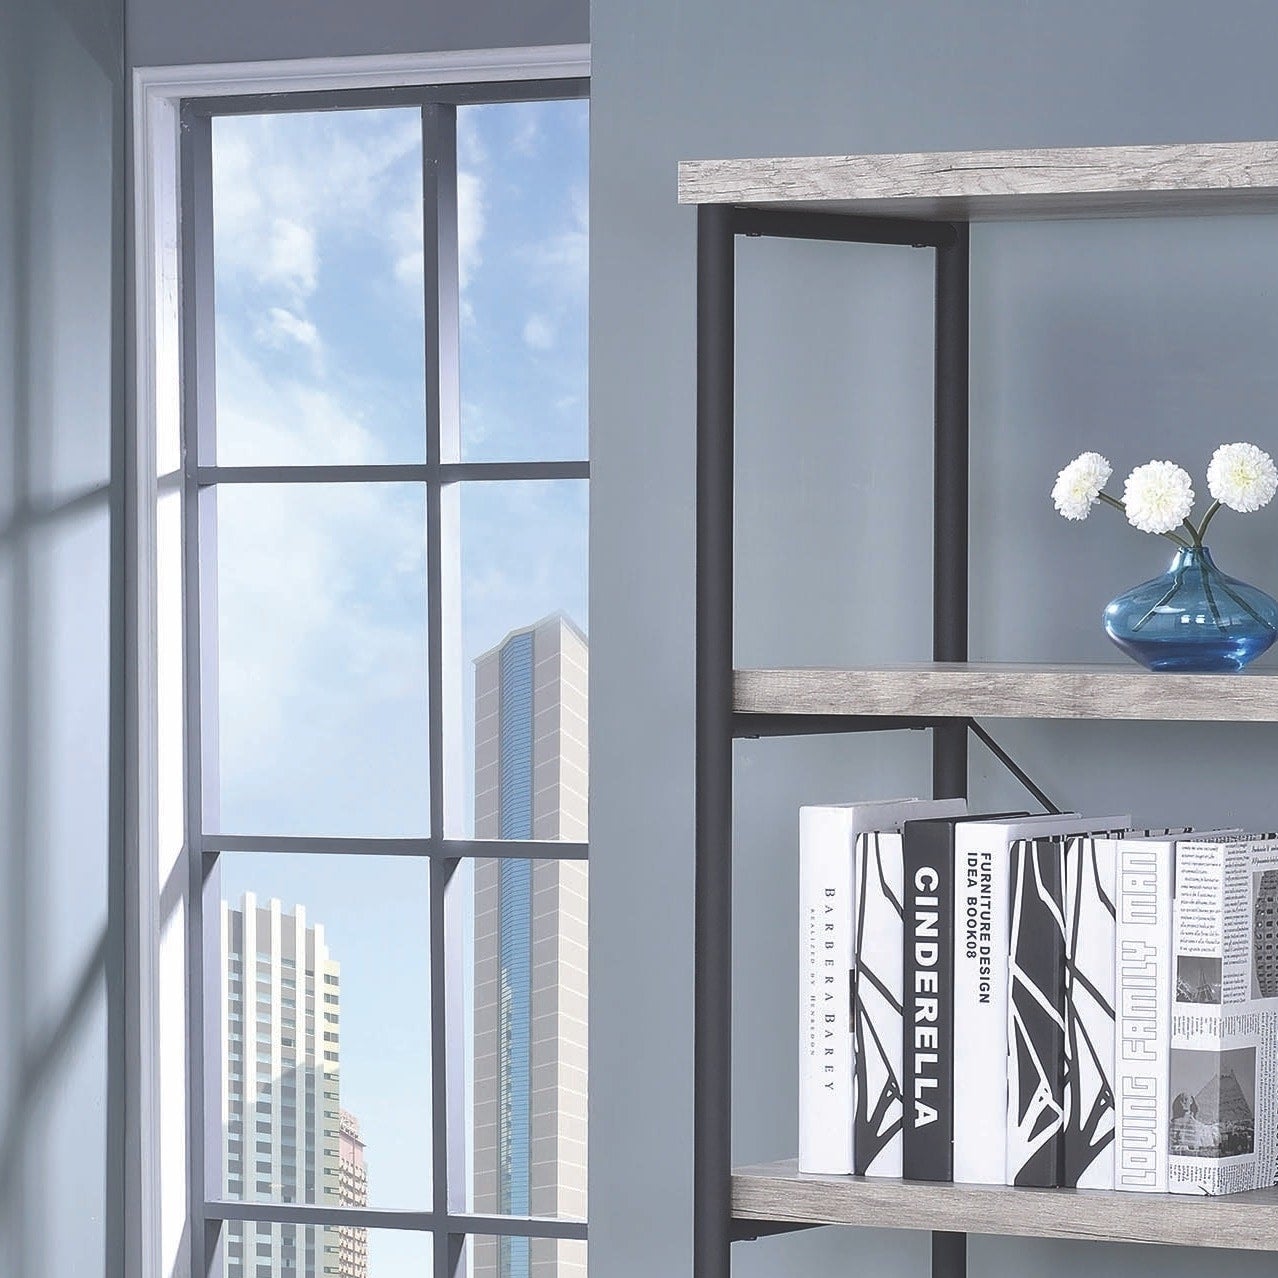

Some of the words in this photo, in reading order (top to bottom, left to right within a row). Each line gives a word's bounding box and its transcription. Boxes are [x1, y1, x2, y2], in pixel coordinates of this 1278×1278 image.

[967, 852, 977, 888] IDEA
[980, 852, 991, 942] FURNITURE
[1121, 852, 1157, 925] MAN
[966, 897, 977, 959] BOOK08
[914, 866, 939, 1128] CINDERELLA
[980, 945, 991, 1003] DESIGN
[1121, 940, 1157, 1061] FAMILY
